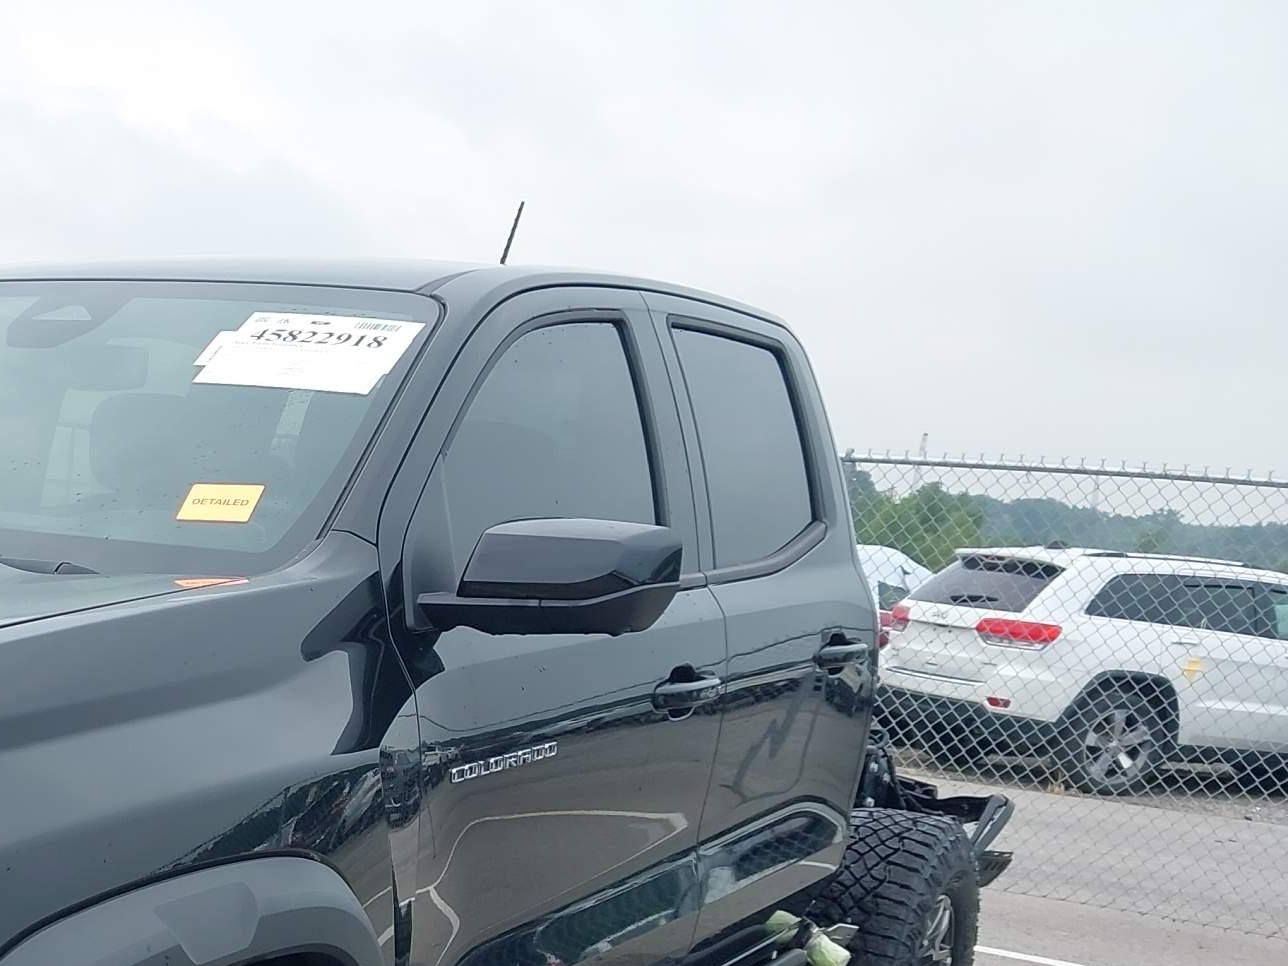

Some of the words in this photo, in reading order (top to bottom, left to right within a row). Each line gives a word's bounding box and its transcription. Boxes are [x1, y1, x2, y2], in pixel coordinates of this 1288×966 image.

[249, 327, 389, 350] 45822918
[191, 497, 250, 507] DETAILED
[450, 741, 558, 782] COLORADO
